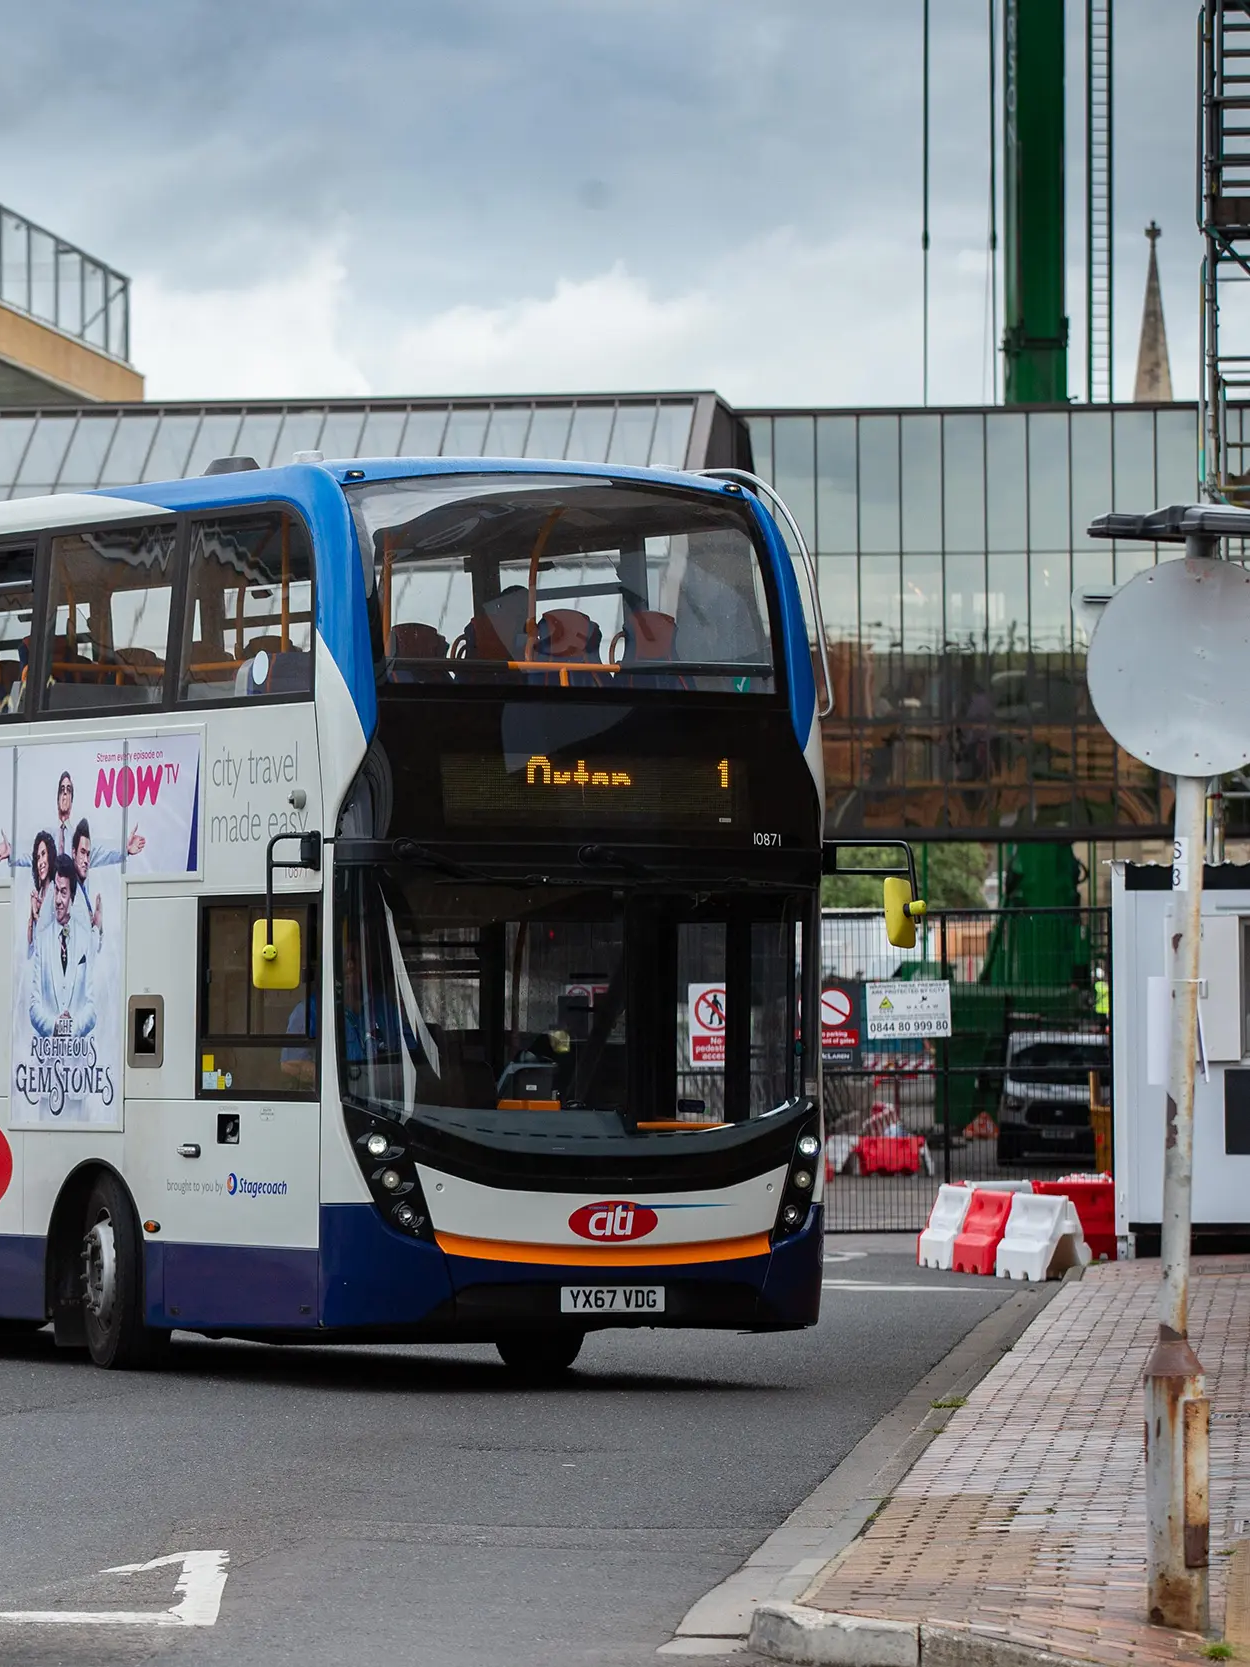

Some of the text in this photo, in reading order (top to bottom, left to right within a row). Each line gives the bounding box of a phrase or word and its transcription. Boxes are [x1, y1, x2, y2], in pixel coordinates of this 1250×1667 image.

[96, 749, 164, 762] Stream every episode on
[213, 741, 298, 798] city travel
[718, 758, 729, 788] 1
[94, 763, 180, 808] NOW TV
[211, 801, 309, 843] made easy
[753, 832, 781, 847] 10871
[870, 1020, 949, 1032] 0844 80 999 80
[31, 1036, 97, 1068] RIGHTEOUS
[710, 1036, 723, 1045] No
[702, 1052, 725, 1061] acces
[16, 1060, 114, 1116] GEMSTONES
[167, 1178, 287, 1198] brought to you by Stagecoach
[588, 1204, 635, 1236] citi
[570, 1290, 657, 1308] YX67 VDG
